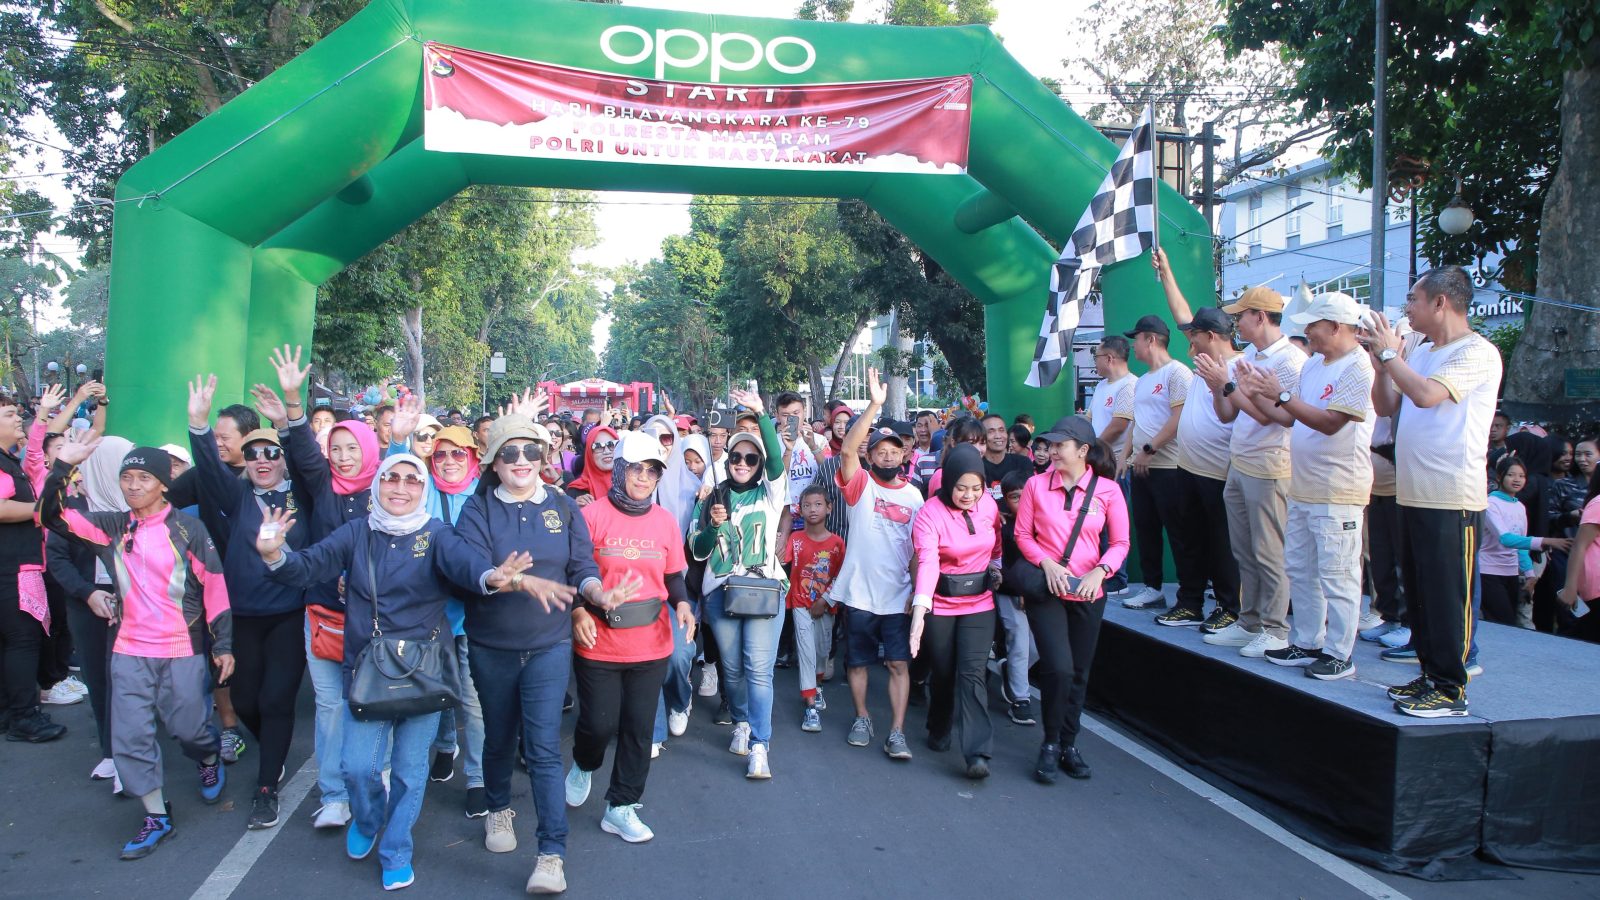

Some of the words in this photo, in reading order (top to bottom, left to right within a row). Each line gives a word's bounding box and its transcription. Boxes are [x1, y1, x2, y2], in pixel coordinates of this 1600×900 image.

[626, 80, 780, 103] START
[531, 100, 592, 118] HARI
[603, 104, 789, 127] BHAYANGKARA
[800, 115, 870, 129] KE-79
[573, 121, 700, 142] POLRESTA
[712, 129, 831, 146] MATARAM
[529, 135, 604, 154] POLRI
[614, 142, 698, 159] UNTUK
[708, 146, 868, 165] MASYARAKAT
[790, 466, 813, 478] RUN
[606, 537, 655, 549] GUCCI
